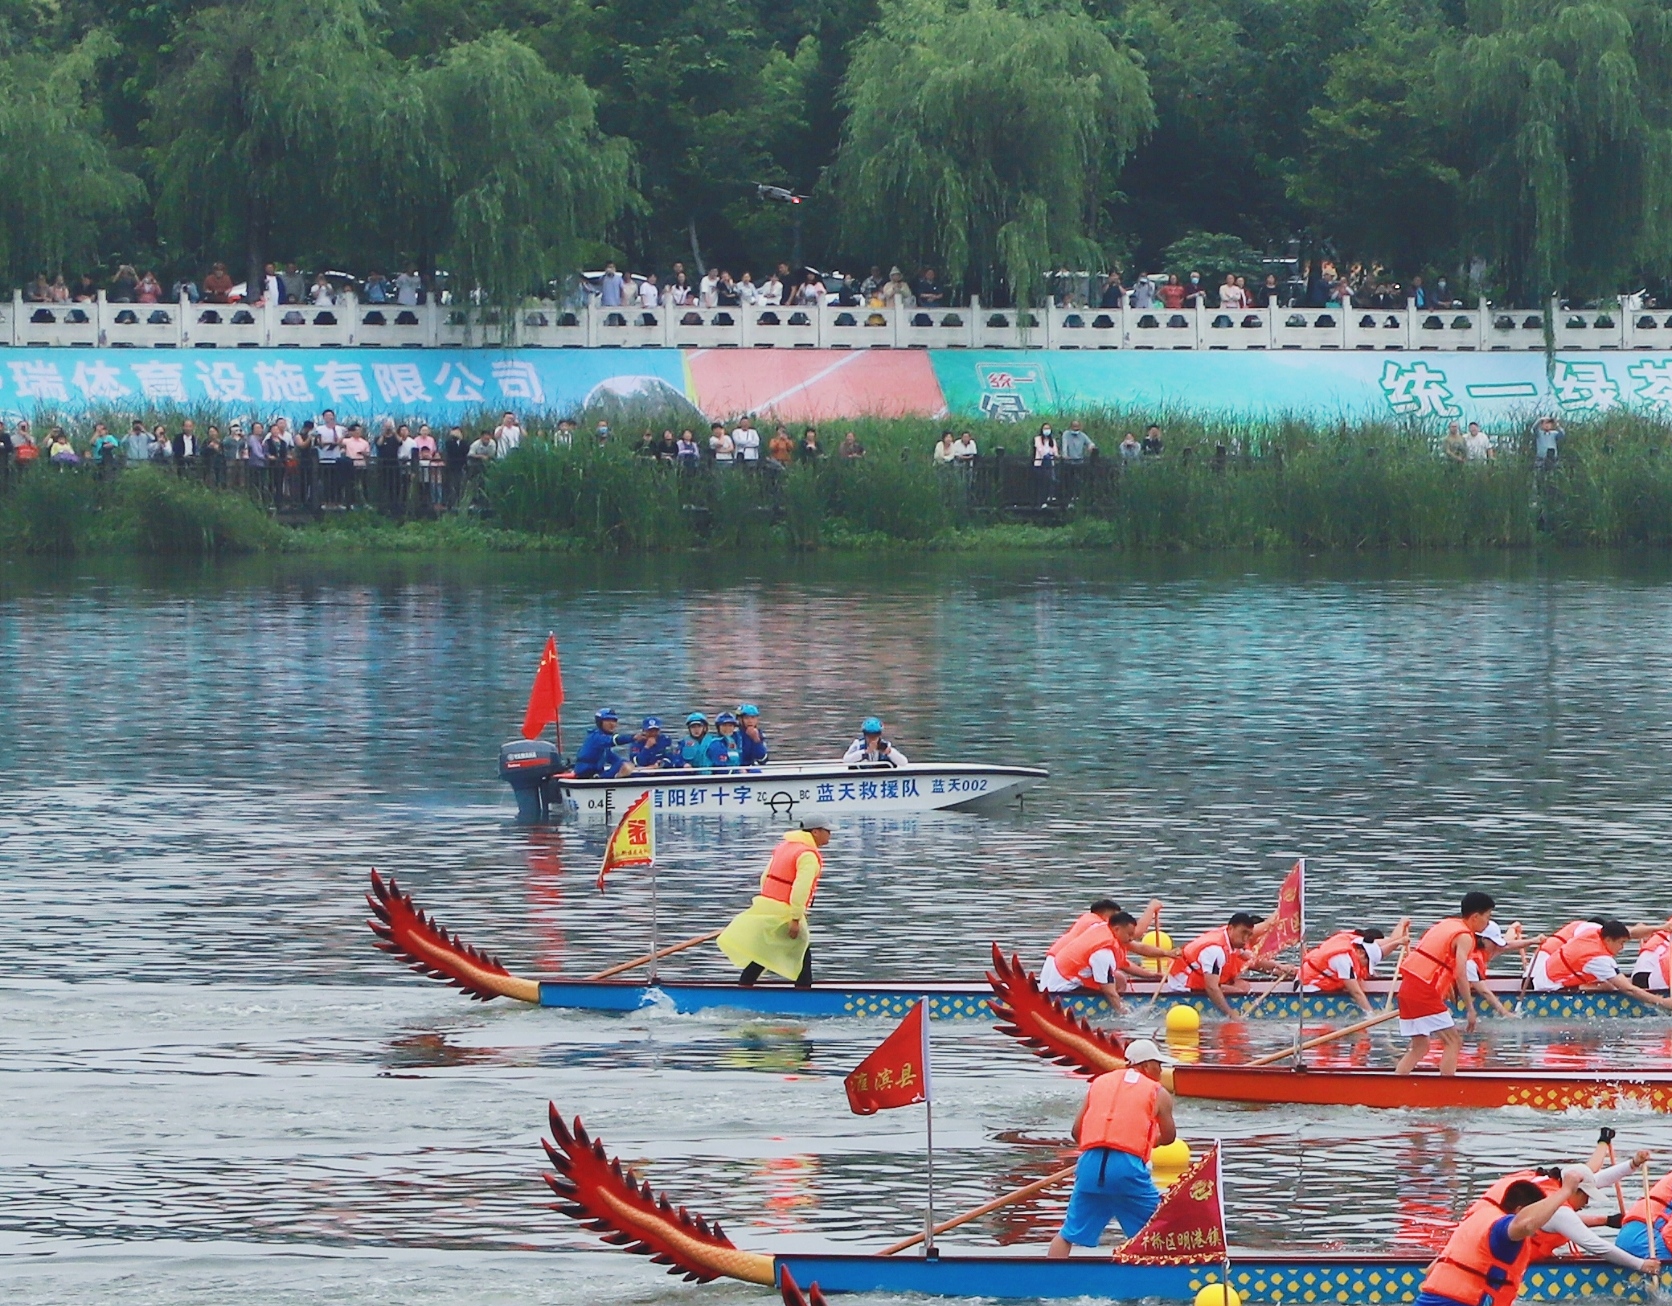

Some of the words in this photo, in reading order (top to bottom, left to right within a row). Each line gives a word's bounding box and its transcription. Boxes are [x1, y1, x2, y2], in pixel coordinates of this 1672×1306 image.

[0, 359, 546, 405] 瑞体育设施有限公司
[816, 779, 920, 803] 蓝天救援队
[932, 778, 988, 794] 蓝天002
[757, 791, 768, 802] ZC
[799, 789, 811, 800] BC
[588, 799, 604, 809] 0.4
[1141, 1226, 1223, 1252] 平桥区明港镇
